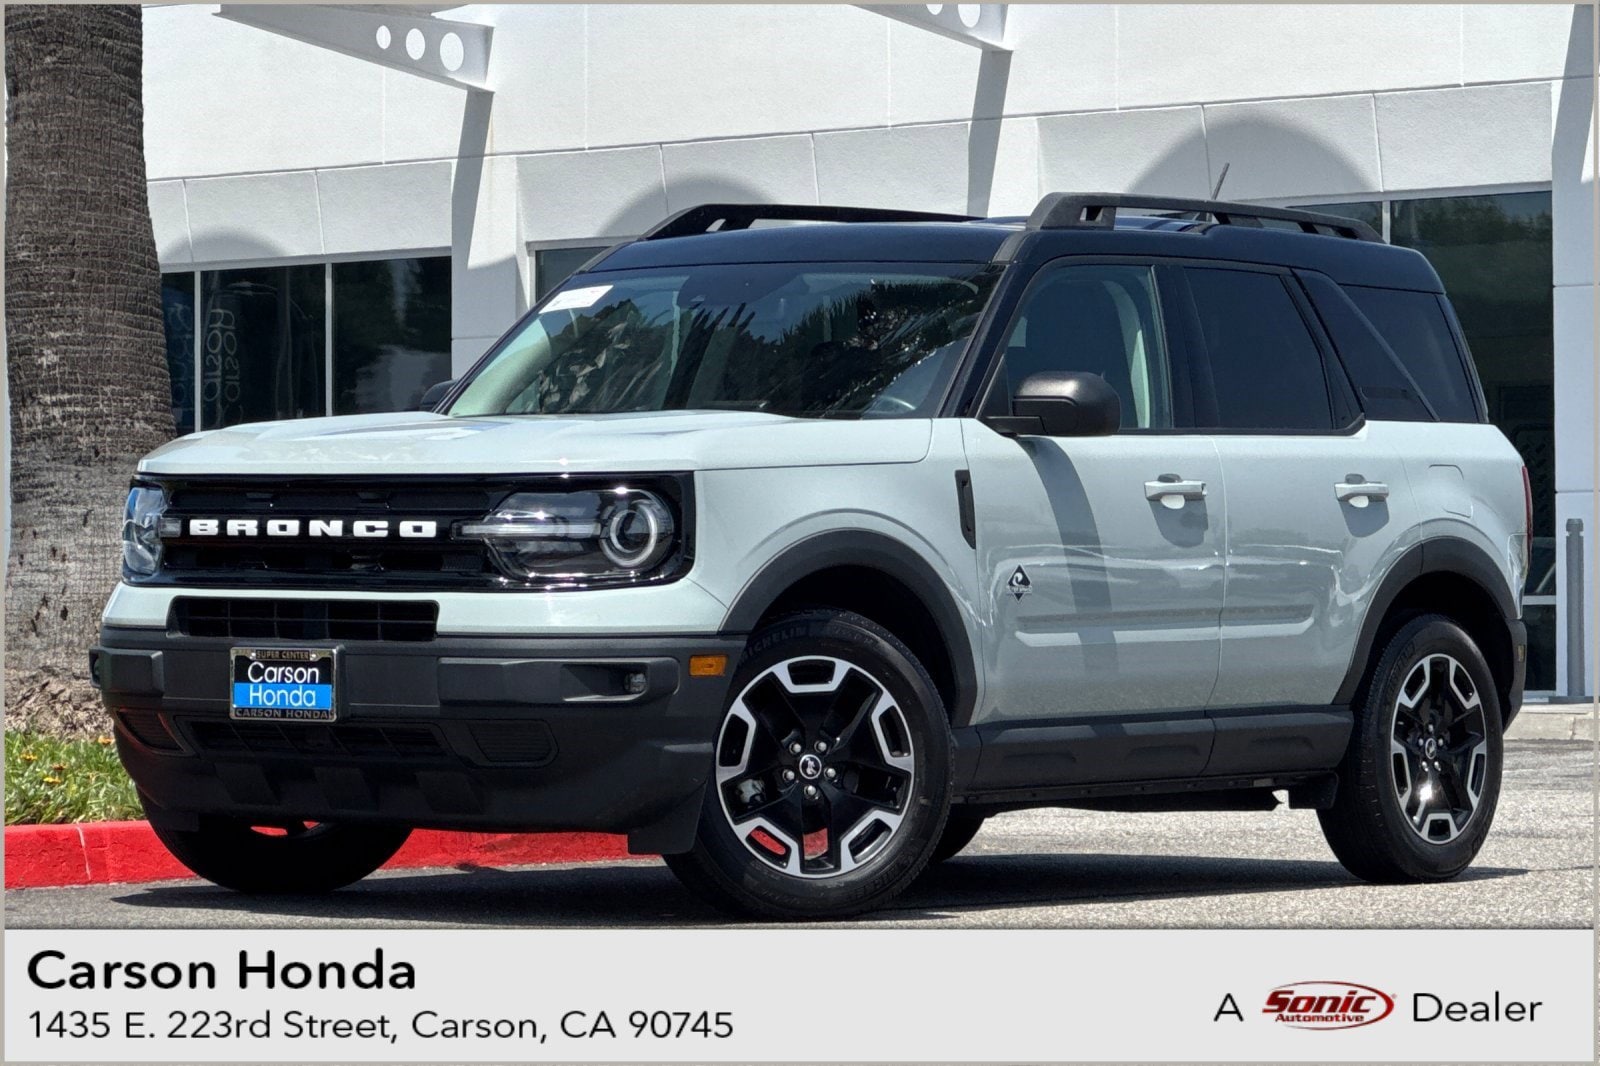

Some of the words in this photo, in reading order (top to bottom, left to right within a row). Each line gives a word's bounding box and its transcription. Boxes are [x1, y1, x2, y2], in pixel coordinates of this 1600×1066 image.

[189, 519, 437, 538] BRONCO
[256, 650, 280, 659] SUPER
[281, 651, 309, 660] CENTER
[248, 661, 319, 684] Carson
[249, 684, 316, 707] Honda
[236, 708, 281, 718] CARSON
[286, 710, 330, 719] HONDA
